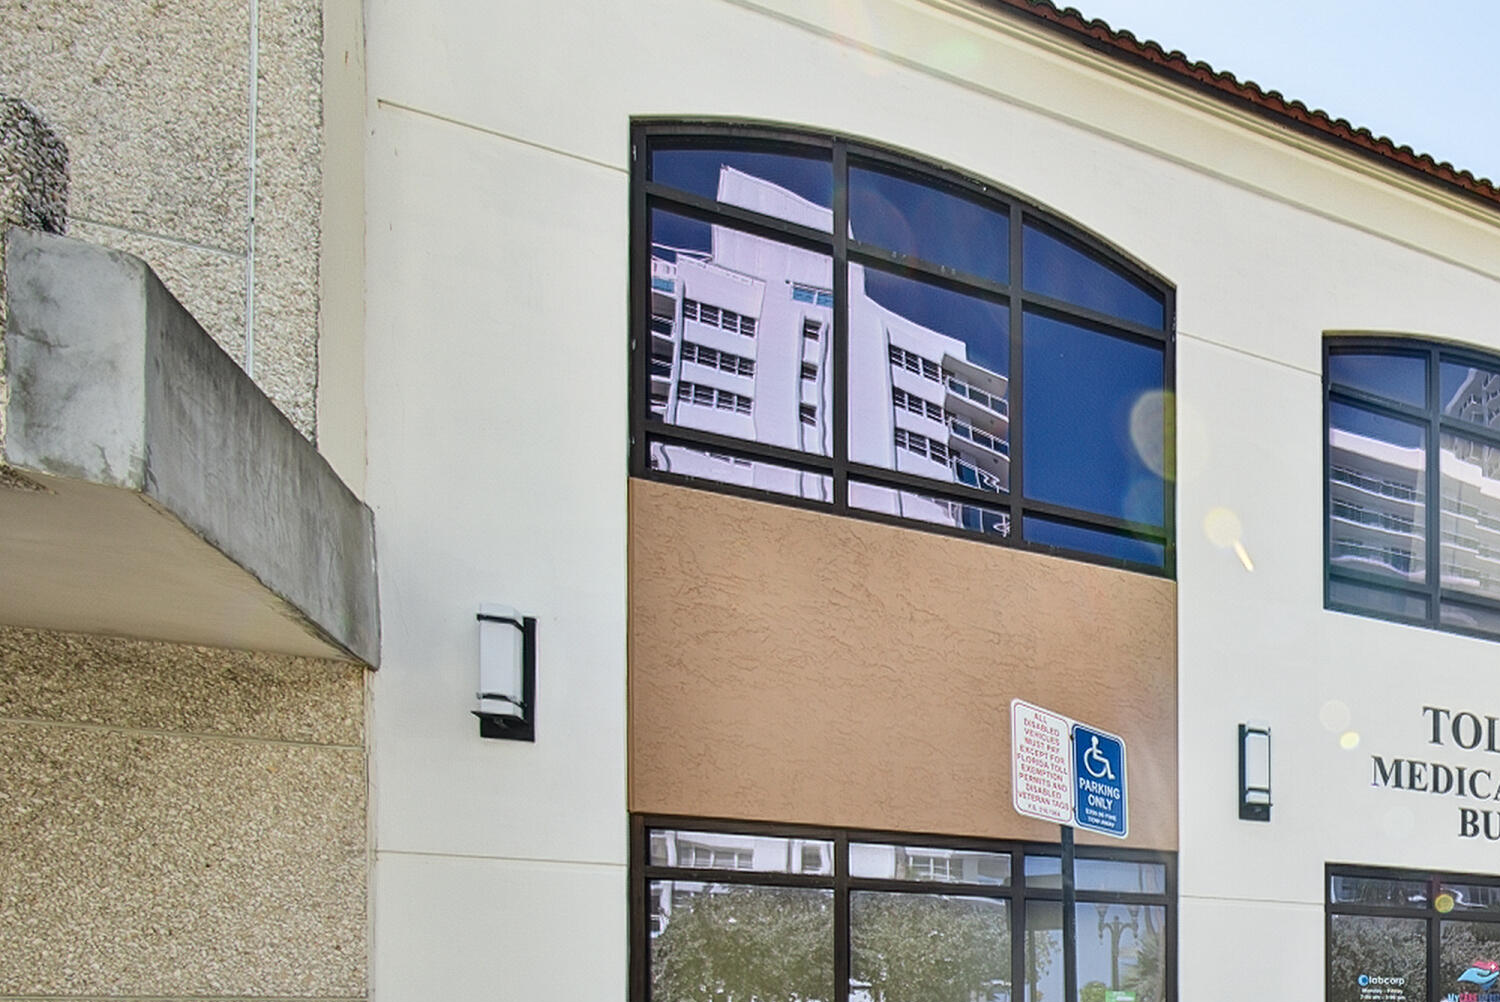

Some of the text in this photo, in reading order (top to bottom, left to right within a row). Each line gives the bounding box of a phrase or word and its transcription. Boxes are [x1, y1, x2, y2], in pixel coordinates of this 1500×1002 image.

[1024, 718, 1059, 736] DISABLED
[1024, 728, 1059, 746] VEHICLES
[1017, 752, 1067, 775] FLORIDA TOLL
[1020, 745, 1064, 765] EXCEPT FOR
[1026, 783, 1061, 799] DISABLED
[1079, 777, 1120, 800] PARKING
[1088, 794, 1113, 811] ONLY
[1369, 976, 1405, 987] labcorp
